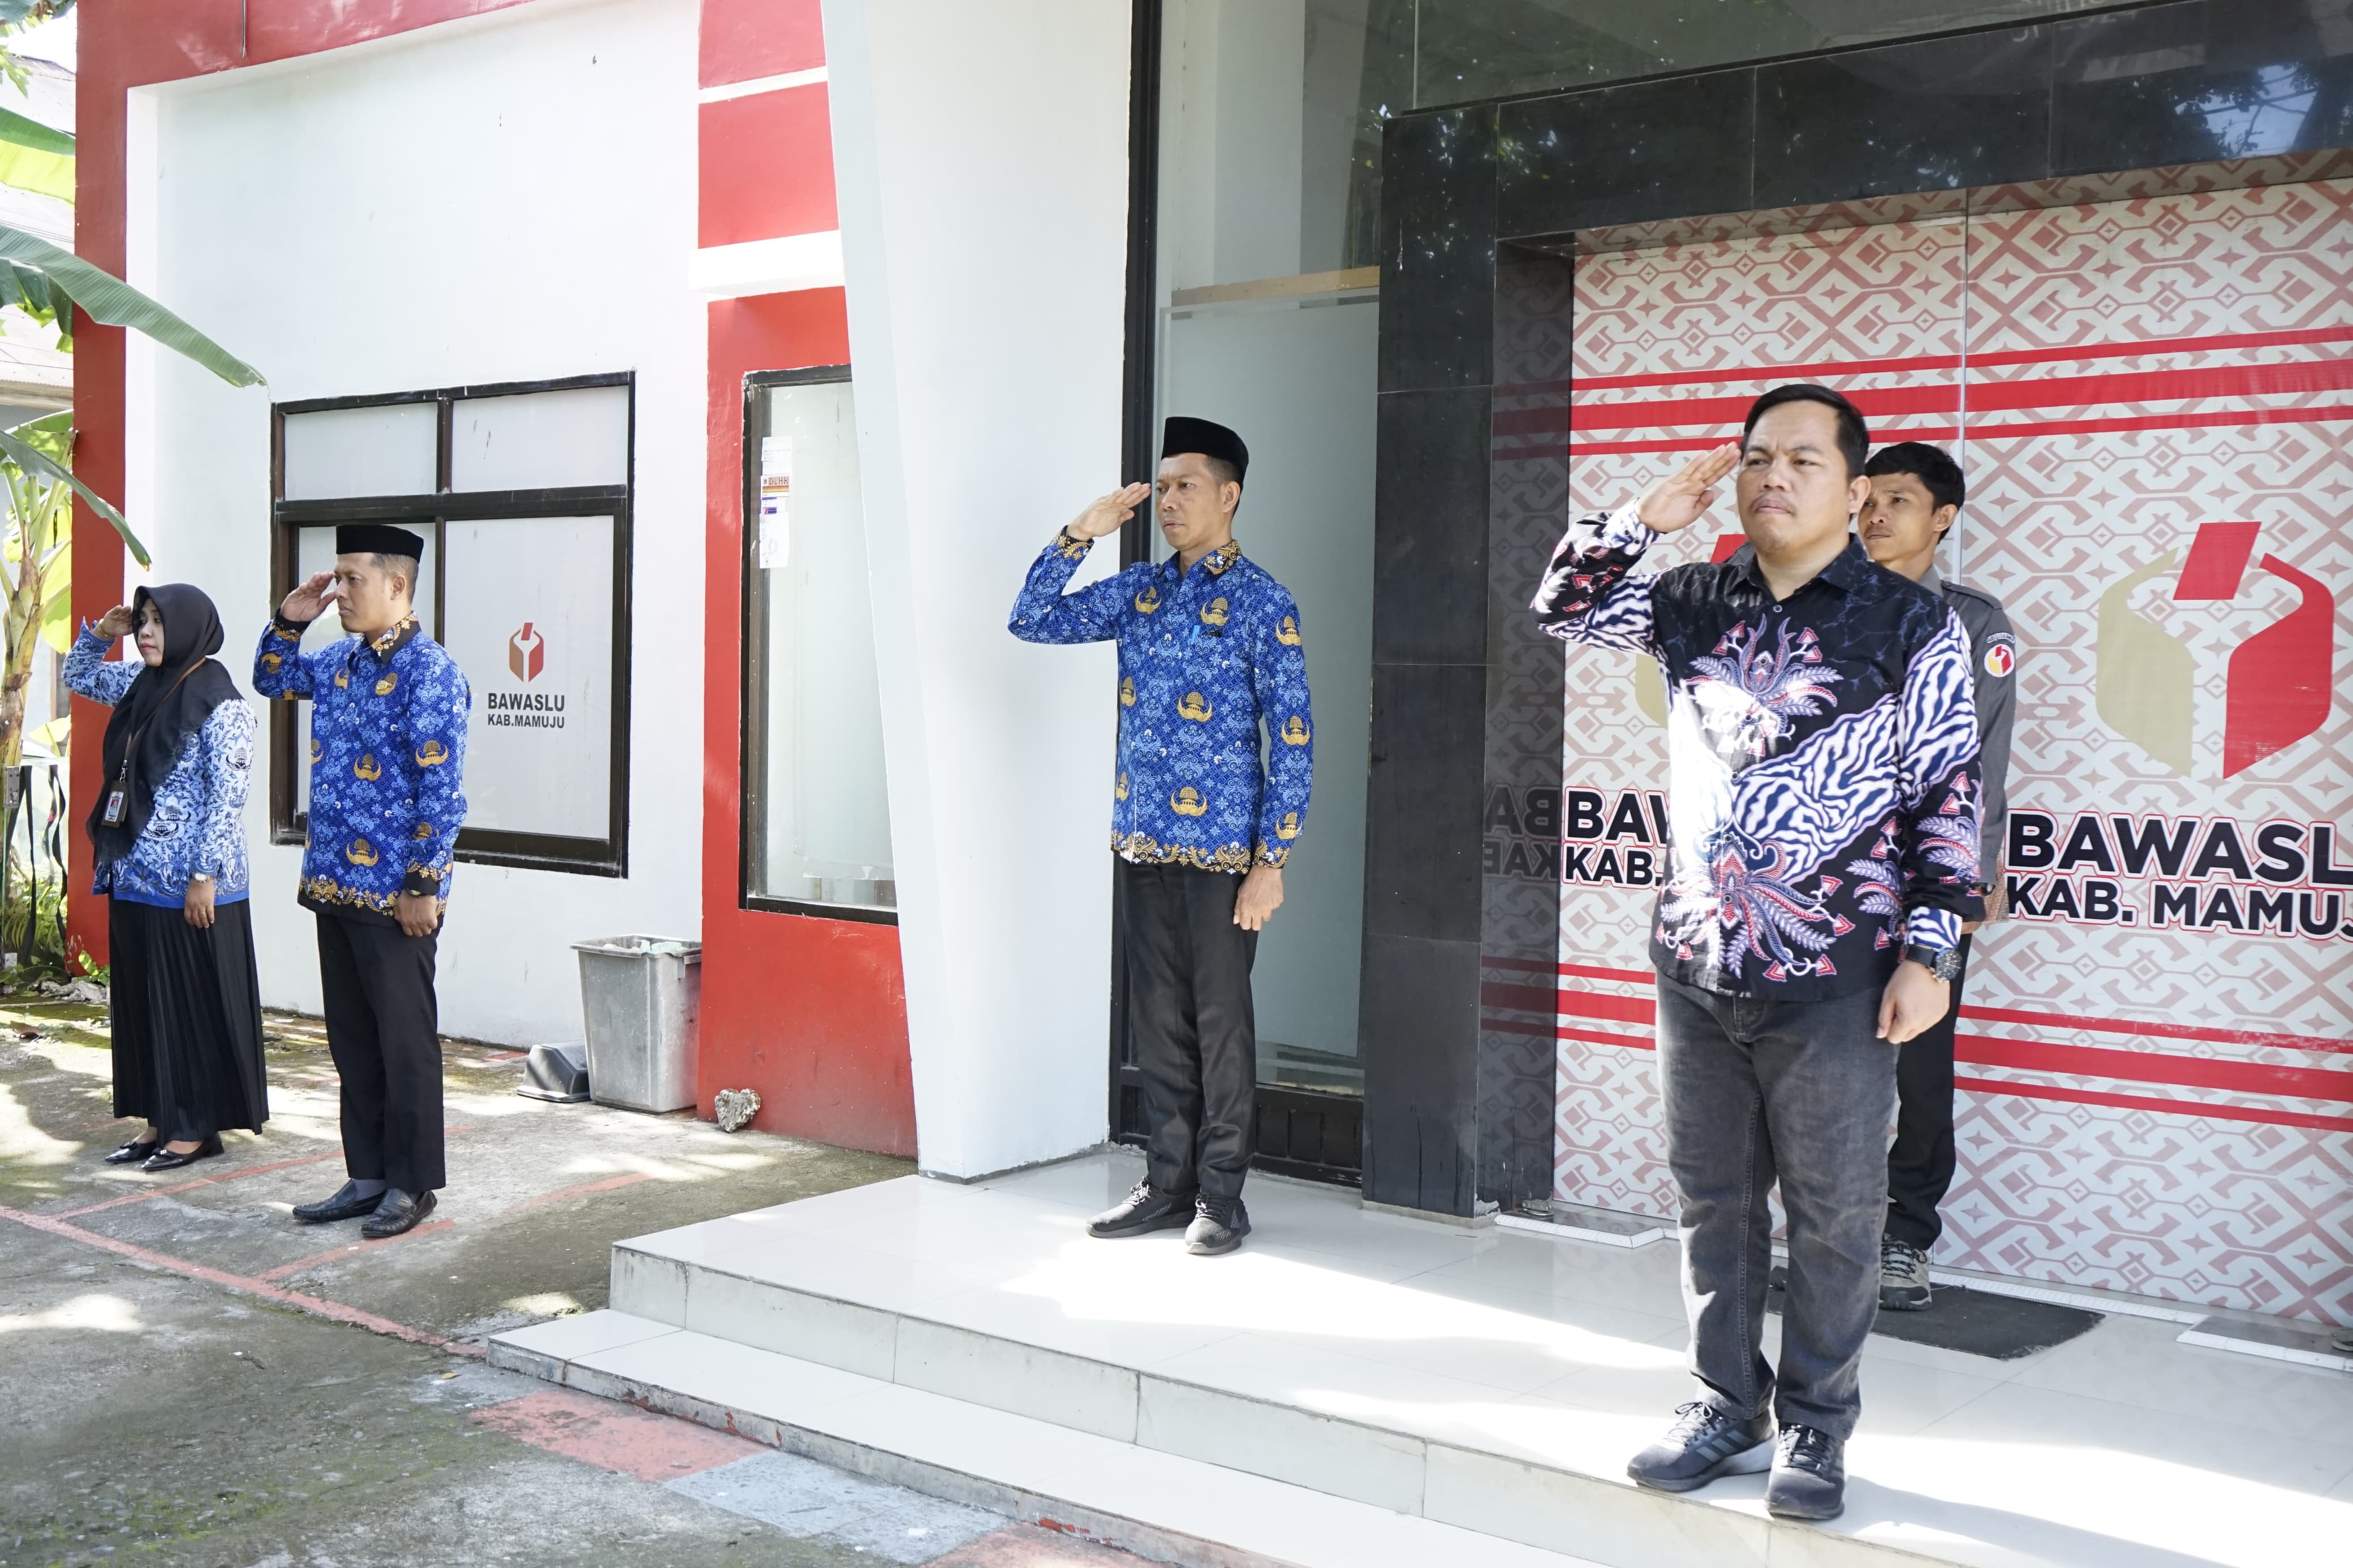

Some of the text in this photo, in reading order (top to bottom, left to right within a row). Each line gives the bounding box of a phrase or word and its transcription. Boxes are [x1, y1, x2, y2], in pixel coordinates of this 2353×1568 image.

[488, 693, 564, 711] BAWASLU
[488, 714, 564, 728] KAB.MAMUJU
[2009, 876, 2133, 922] KAB.
